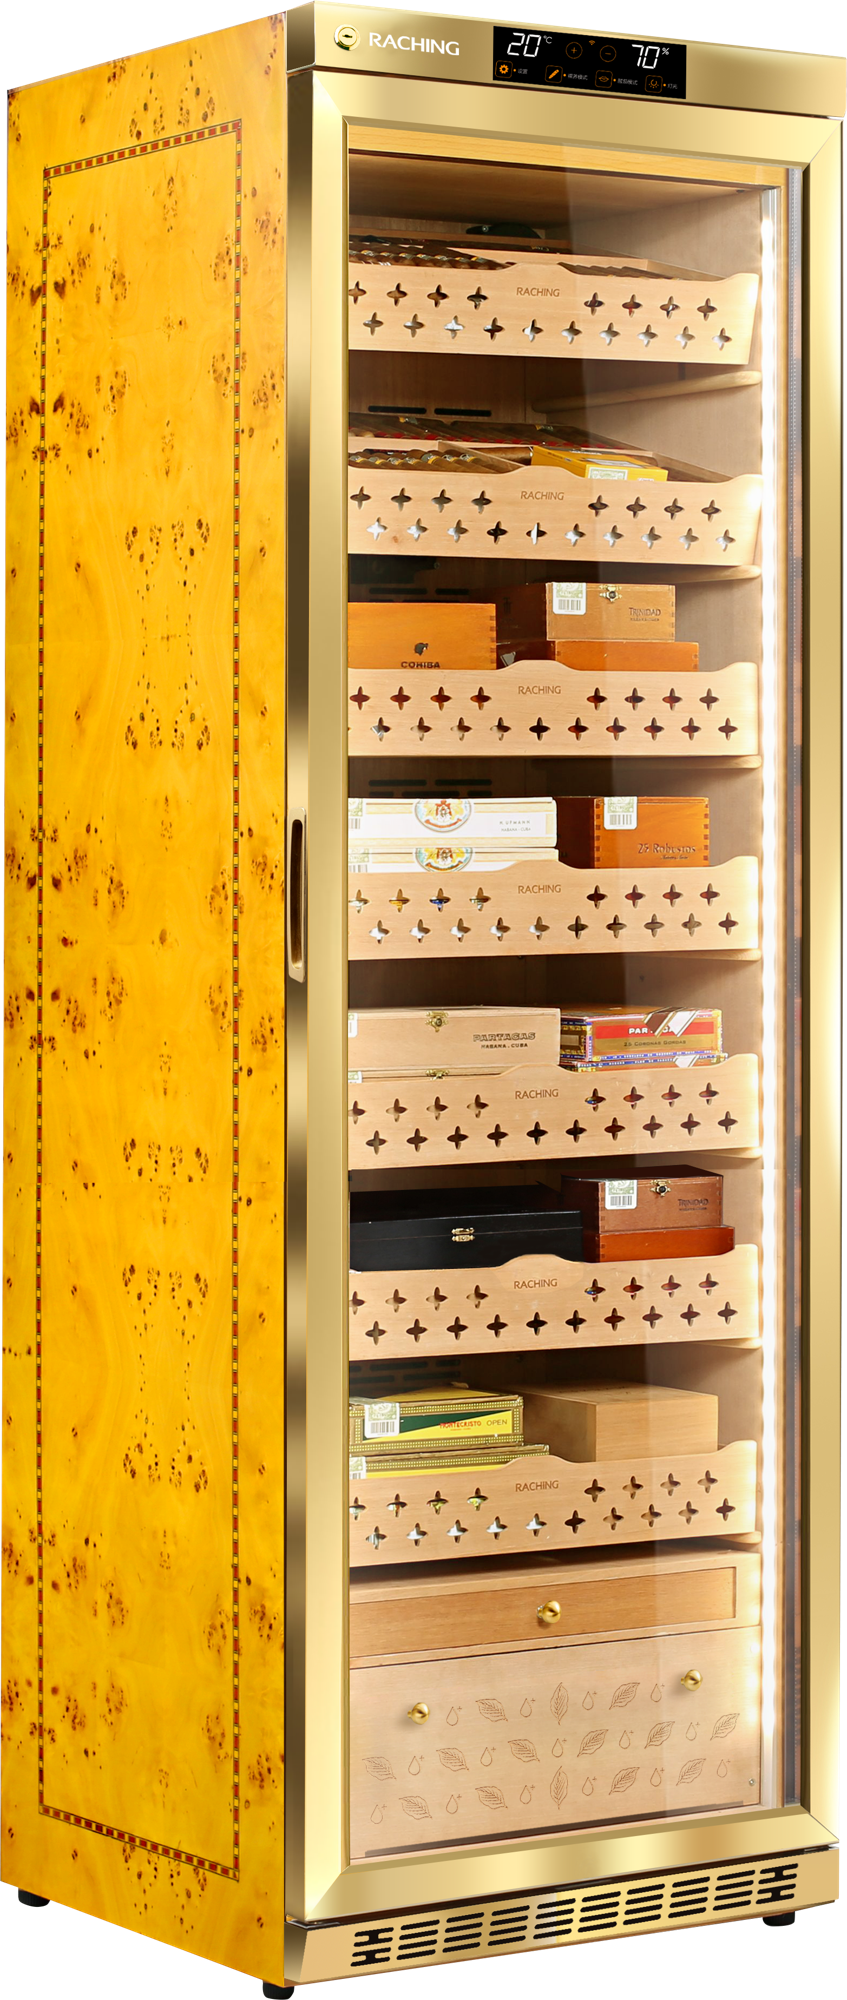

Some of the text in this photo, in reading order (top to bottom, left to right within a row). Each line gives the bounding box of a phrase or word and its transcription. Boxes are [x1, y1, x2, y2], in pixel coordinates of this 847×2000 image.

[369, 32, 460, 56] RACHING
[516, 287, 560, 297] RACHING
[520, 490, 565, 501] RACHING
[629, 607, 662, 616] TRINIDAD
[401, 661, 441, 669] COHIBA
[518, 685, 562, 695] RACHING
[653, 842, 696, 854] Robustos
[518, 884, 562, 895] RACHING
[515, 1089, 559, 1099] RACHING
[514, 1279, 558, 1289] RACHING
[515, 1480, 559, 1492] RACHING
